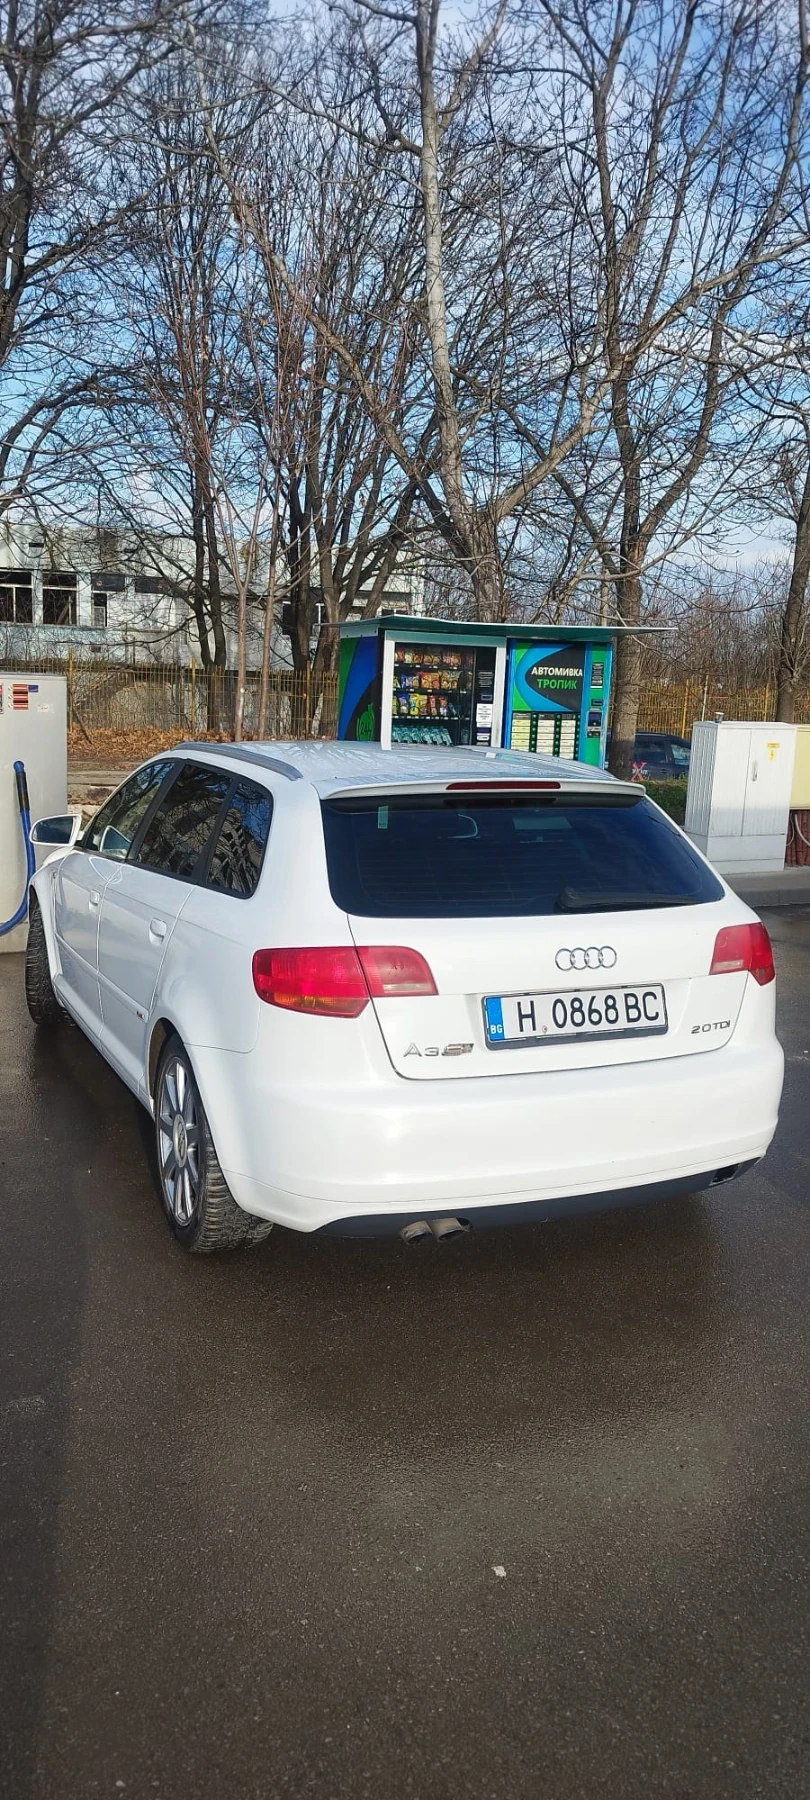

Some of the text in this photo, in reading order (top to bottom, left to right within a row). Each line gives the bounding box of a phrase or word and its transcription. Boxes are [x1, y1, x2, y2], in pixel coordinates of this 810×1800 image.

[531, 667, 583, 677] АВТОМИВКА
[537, 679, 578, 690] ТРОПИК
[516, 991, 660, 1032] H 0868 BC
[491, 1025, 503, 1034] BG
[403, 1042, 440, 1057] A3
